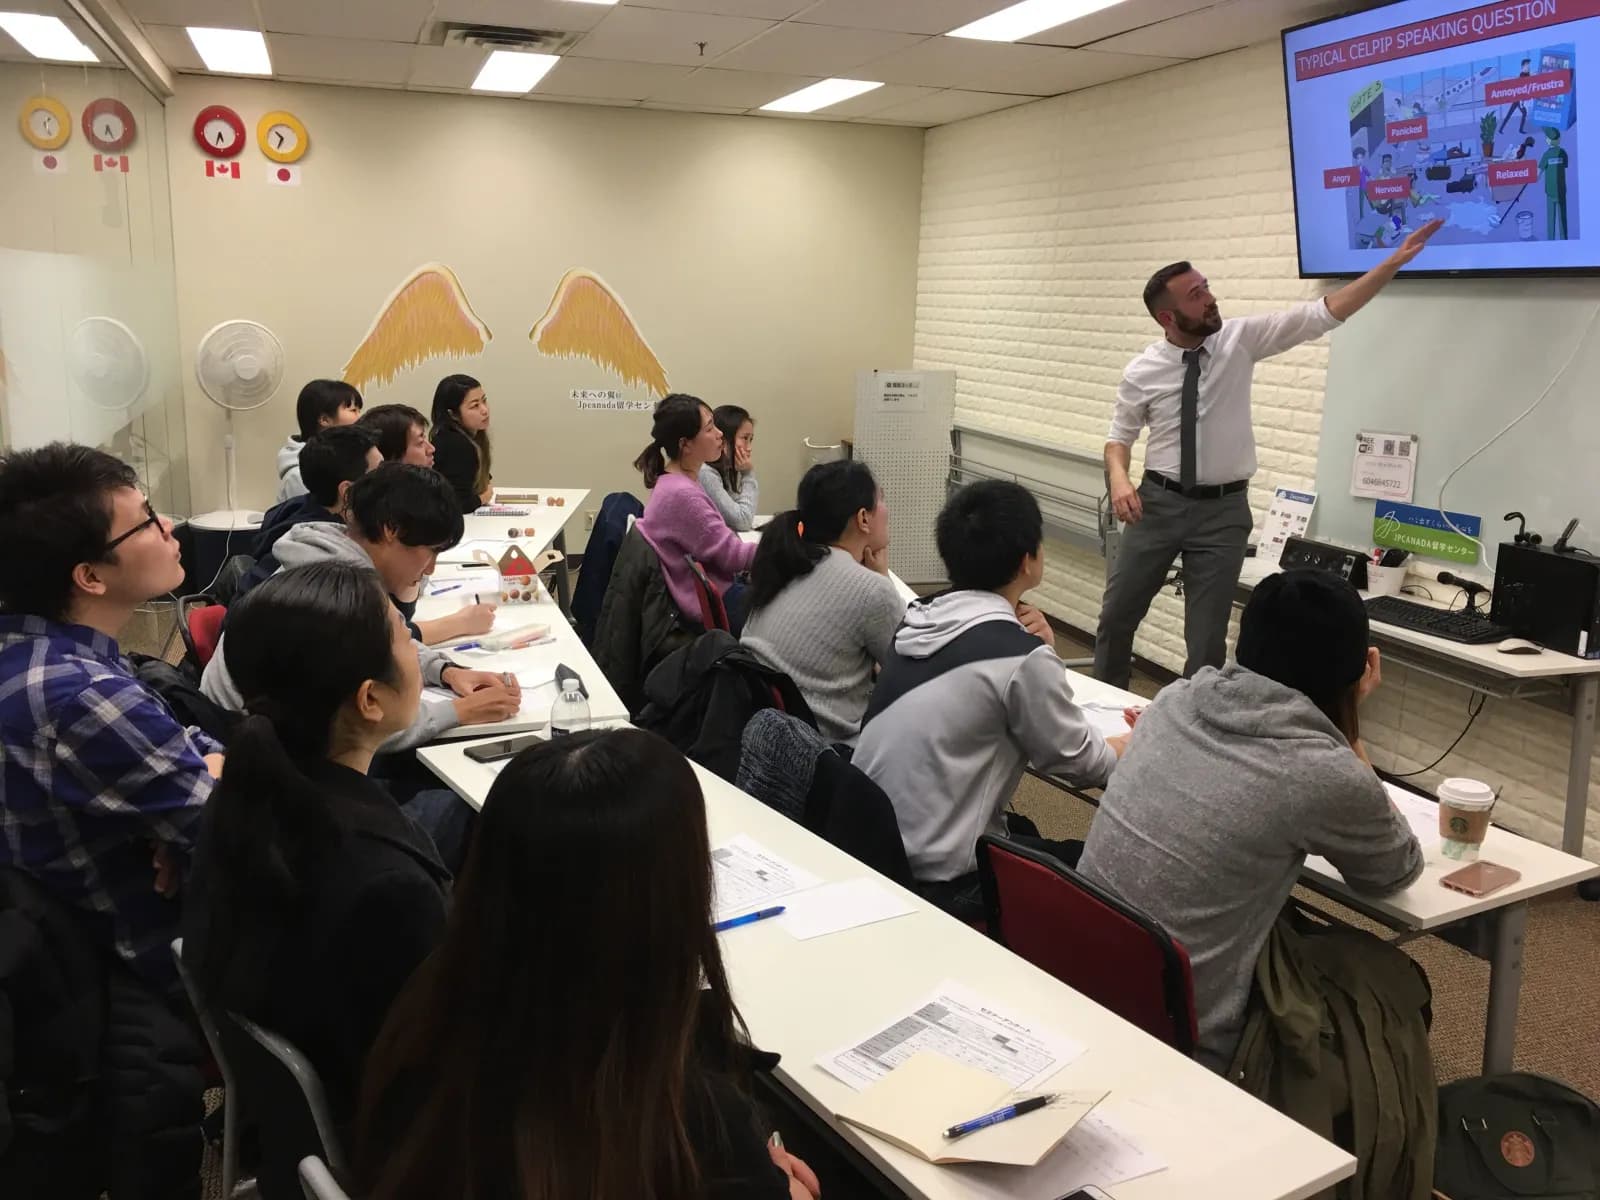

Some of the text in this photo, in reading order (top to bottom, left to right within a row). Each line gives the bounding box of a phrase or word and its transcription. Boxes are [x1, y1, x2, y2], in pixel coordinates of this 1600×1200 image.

[1298, 0, 1556, 72] TYPICAL CELPIP SPEAKING QUESTION
[1491, 79, 1564, 98] Annoyed/Frustra
[1391, 125, 1423, 137] Panicked
[1496, 168, 1529, 179] Relaxed
[1332, 175, 1351, 184] Angry
[1375, 184, 1403, 195] Nervous
